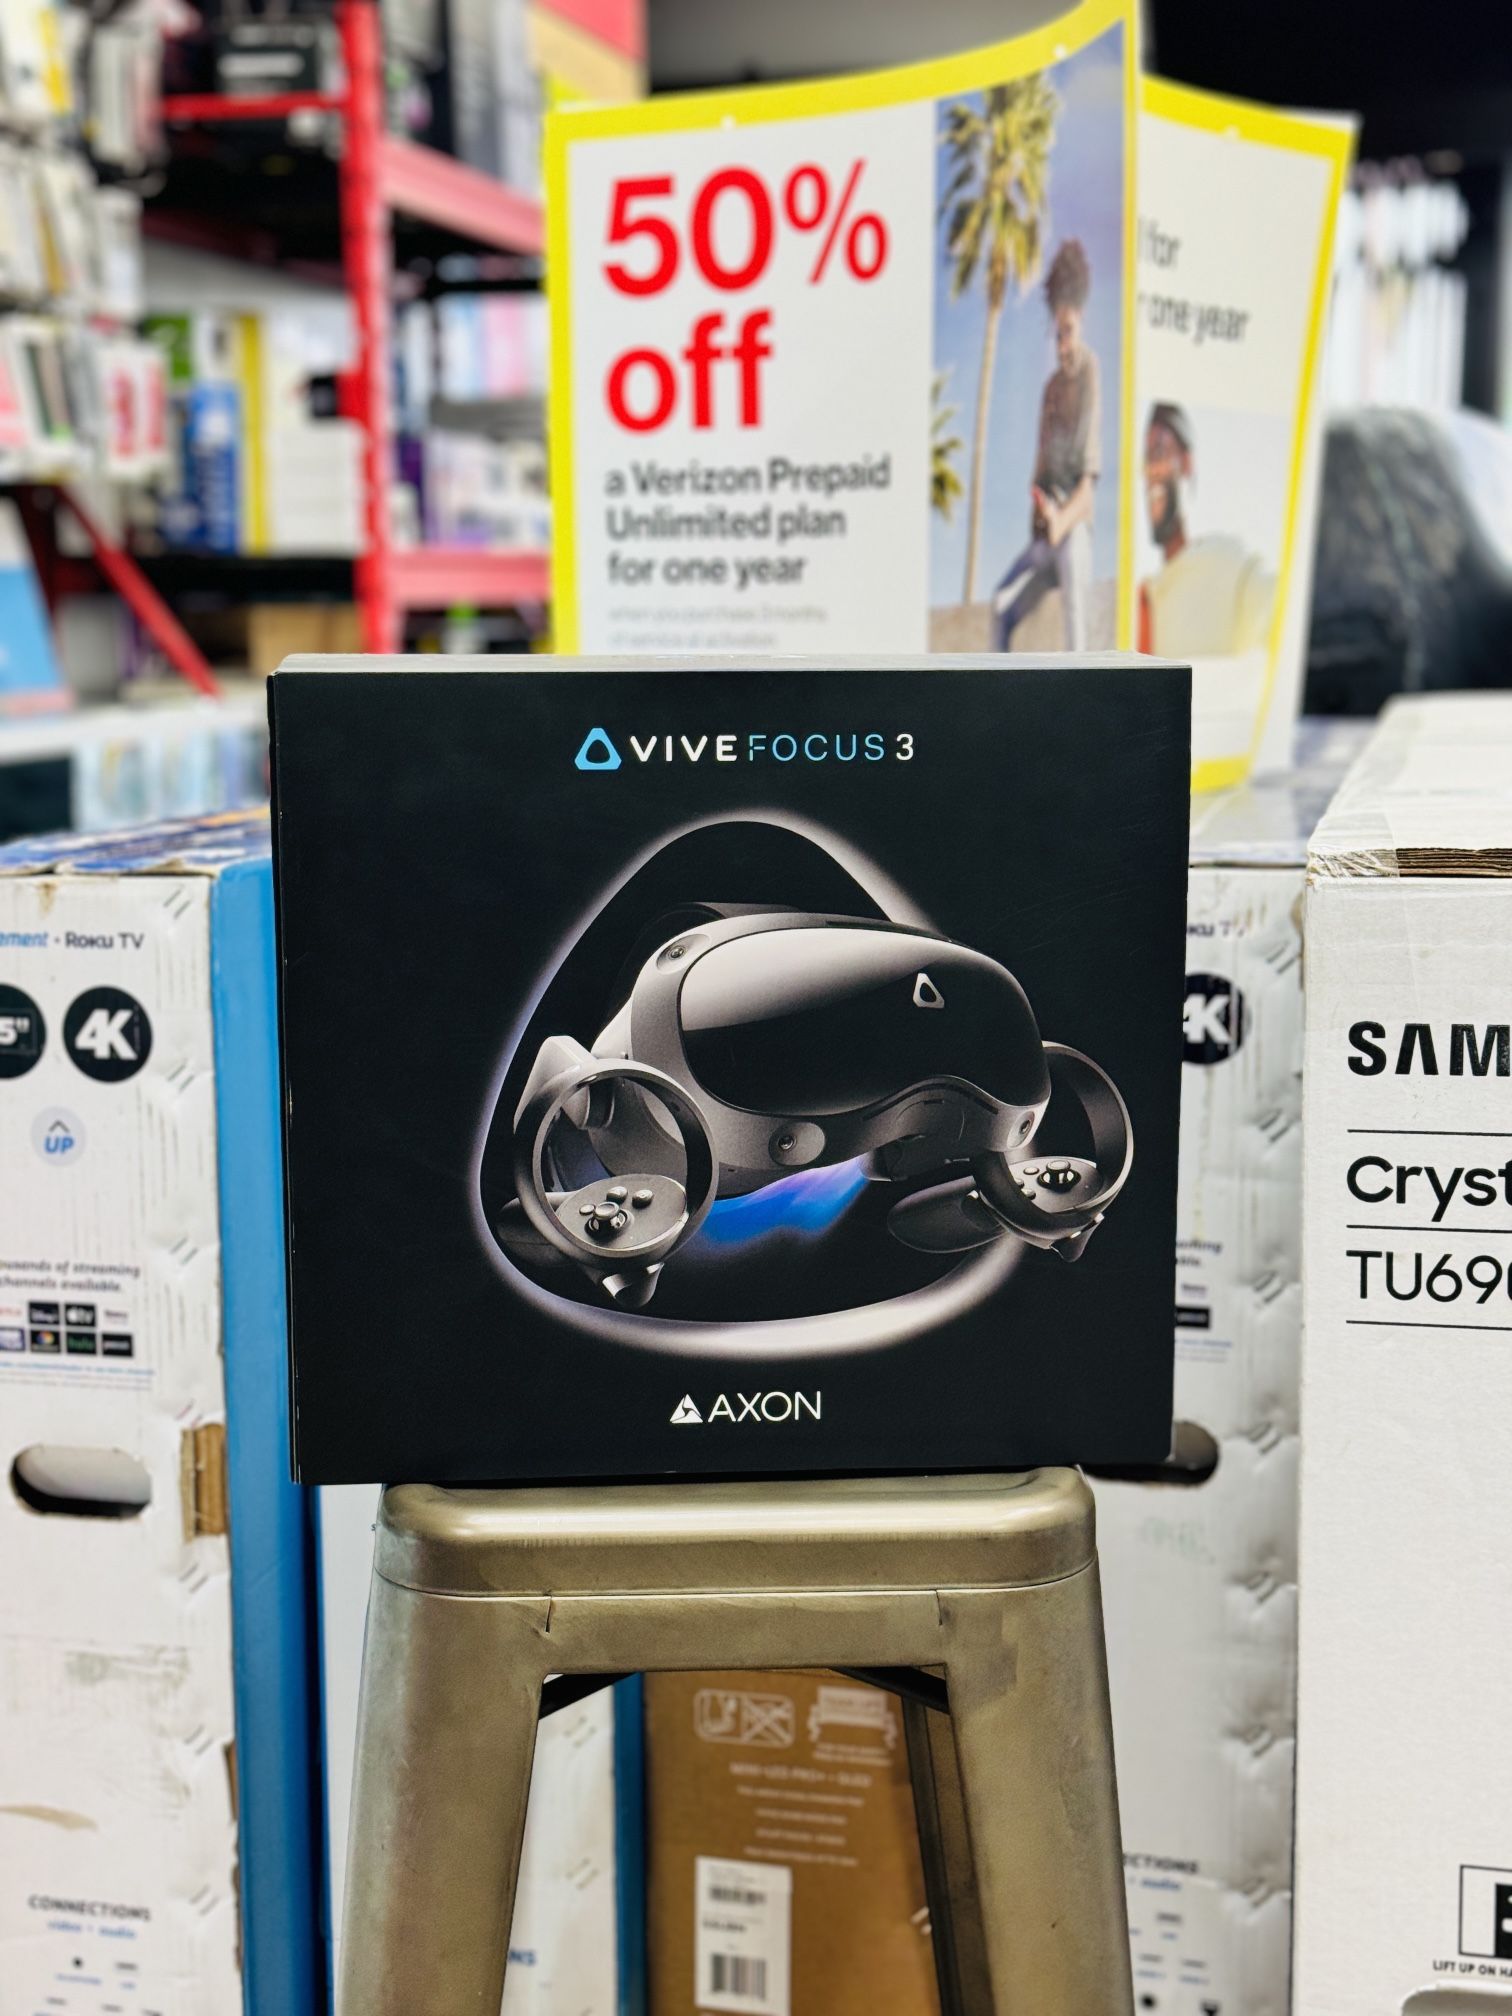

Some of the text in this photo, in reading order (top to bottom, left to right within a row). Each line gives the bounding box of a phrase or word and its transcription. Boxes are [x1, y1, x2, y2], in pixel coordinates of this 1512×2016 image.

[604, 159, 889, 297] 50%
[1148, 219, 1181, 270] for
[1149, 294, 1250, 345] one year
[606, 309, 773, 433] off
[605, 453, 891, 498] a Verizon Prepaid
[605, 503, 846, 545] Unlimited plan
[607, 552, 806, 590] for one year
[629, 733, 915, 762] VIVE FOCUS 3
[65, 932, 113, 949] Roku
[118, 934, 144, 949] TV
[75, 1008, 138, 1060] 4K
[1348, 1021, 1511, 1076] SAM
[45, 1136, 75, 1154] UP
[1346, 1250, 1512, 1304] TU69
[707, 1391, 821, 1422] AXON
[28, 1895, 150, 1921] CONNECTIONS
[1433, 1961, 1456, 1972] LIFT
[1459, 1963, 1475, 1974] UP
[1478, 1965, 1496, 1976] ON
